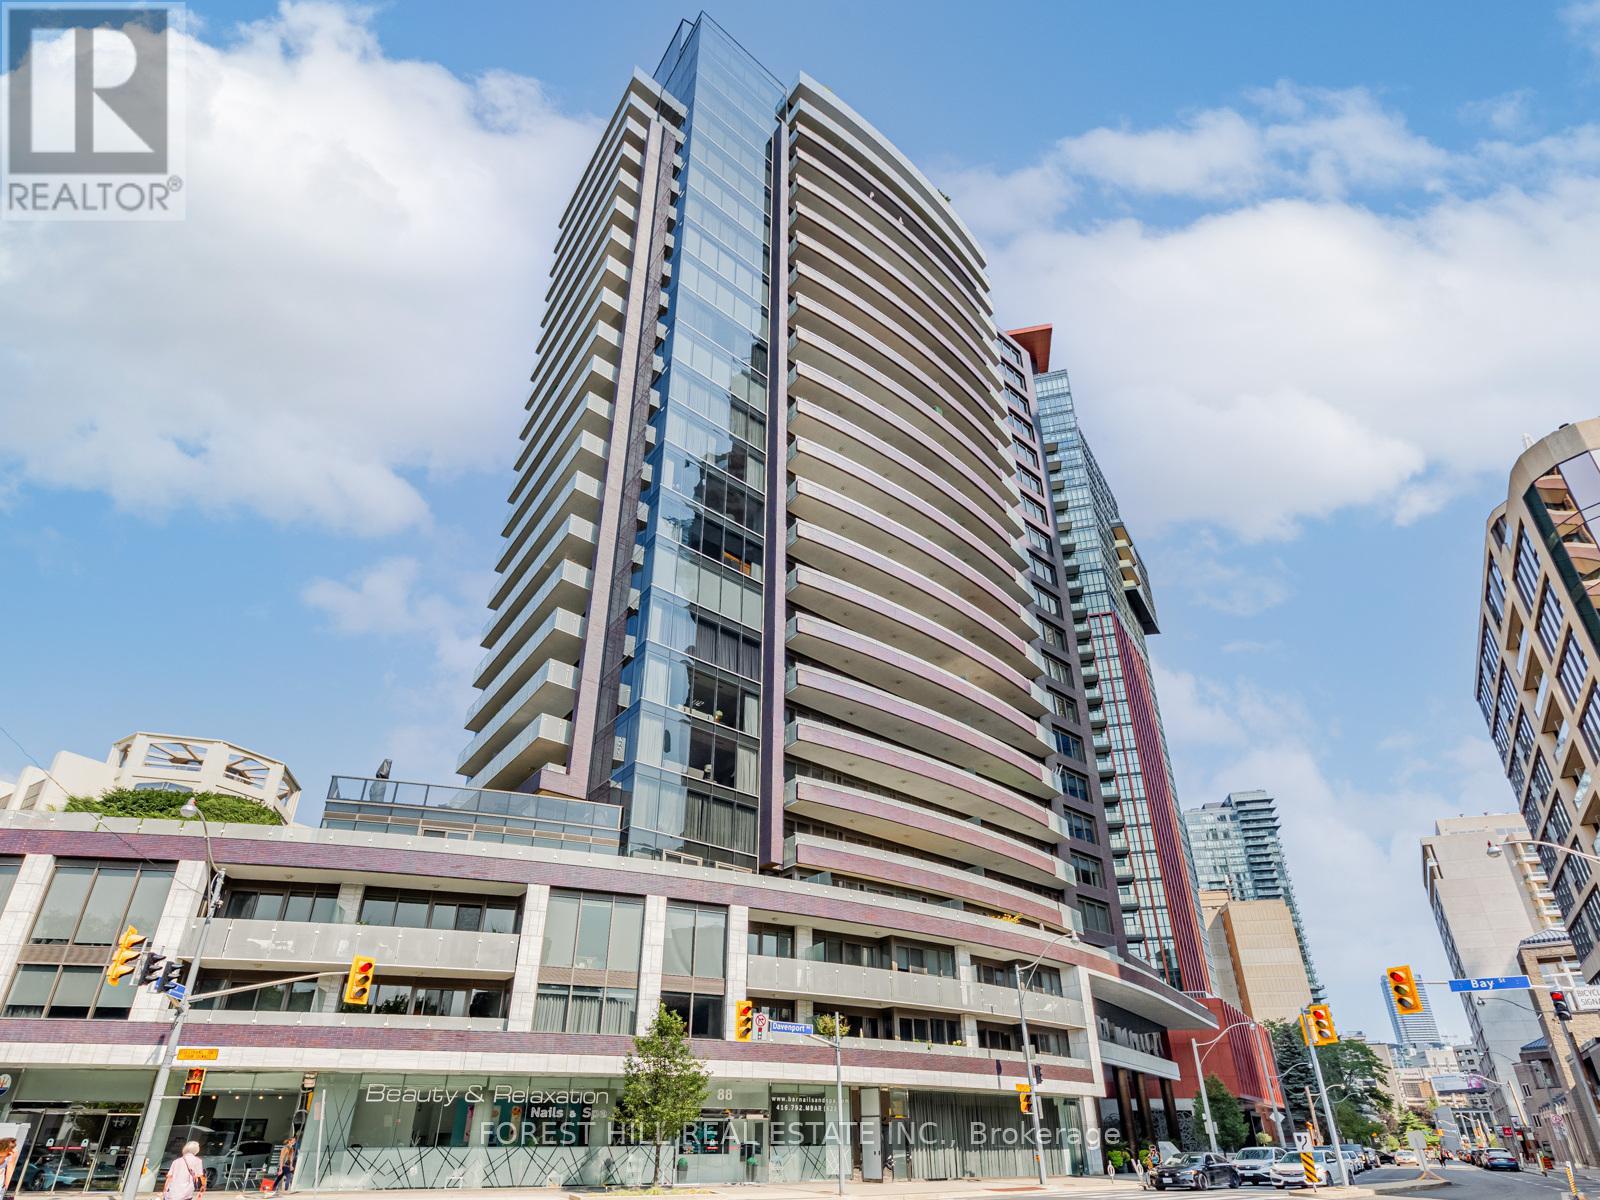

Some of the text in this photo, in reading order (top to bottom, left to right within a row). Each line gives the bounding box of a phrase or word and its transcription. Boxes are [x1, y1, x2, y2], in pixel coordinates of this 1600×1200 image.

[1471, 980, 1493, 989] Bay
[772, 1022, 805, 1032] Davenport
[366, 1084, 609, 1107] Beauty & Relaxation
[717, 1088, 732, 1101] 88
[530, 1107, 563, 1118] Nails
[582, 1107, 608, 1119] Spa
